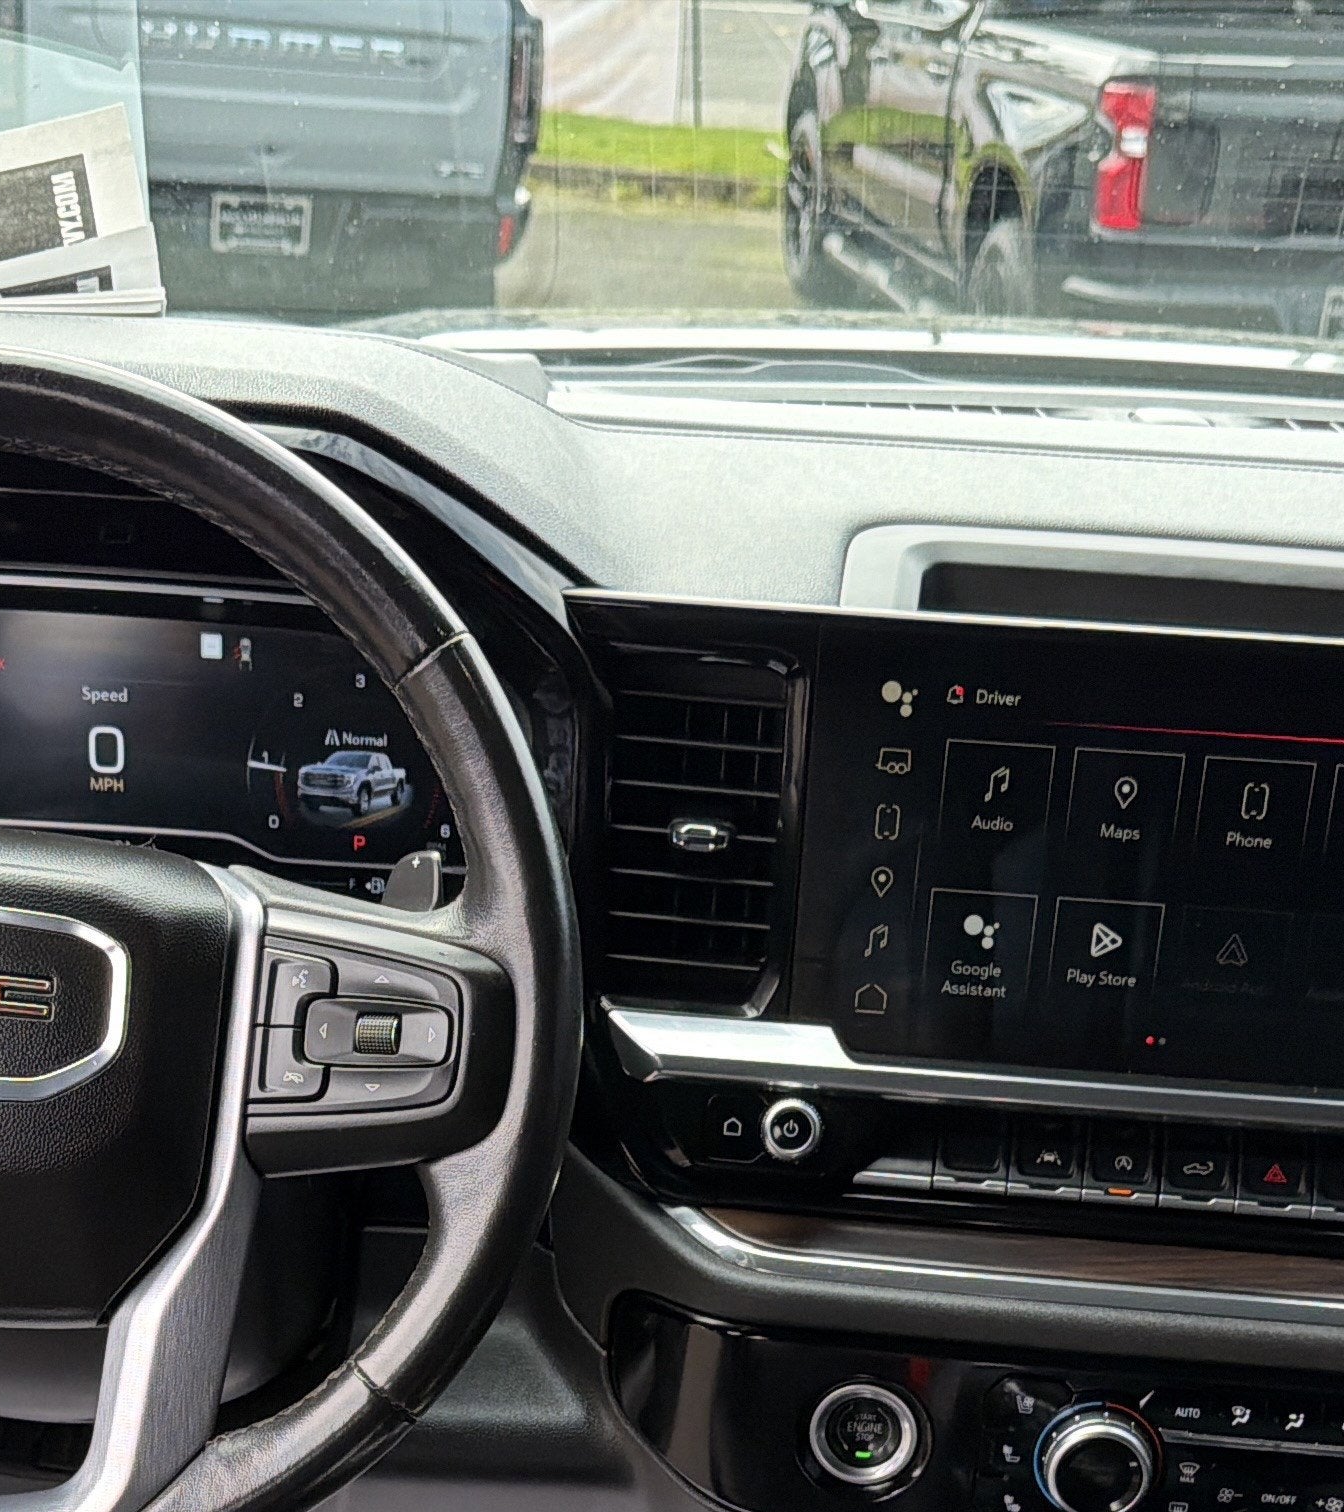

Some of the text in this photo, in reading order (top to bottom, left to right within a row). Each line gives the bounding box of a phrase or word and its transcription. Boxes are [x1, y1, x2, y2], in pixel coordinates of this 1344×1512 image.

[356, 673, 366, 688] 3
[81, 684, 129, 704] Speed
[293, 692, 304, 707] 2
[975, 689, 1022, 707] Driver
[342, 731, 388, 747] Normal
[88, 726, 125, 774] 0
[89, 777, 124, 793] MPH
[268, 814, 280, 829] 0
[971, 815, 1014, 832] Audio
[1100, 823, 1141, 843] Maps
[1225, 830, 1273, 851] Phone
[354, 835, 366, 850] P
[950, 959, 1002, 980] Google
[1066, 968, 1138, 989] Play Store
[941, 980, 1007, 998] Assistant
[1175, 1407, 1202, 1420] AUTO
[1261, 1493, 1298, 1506] ON/OFF
